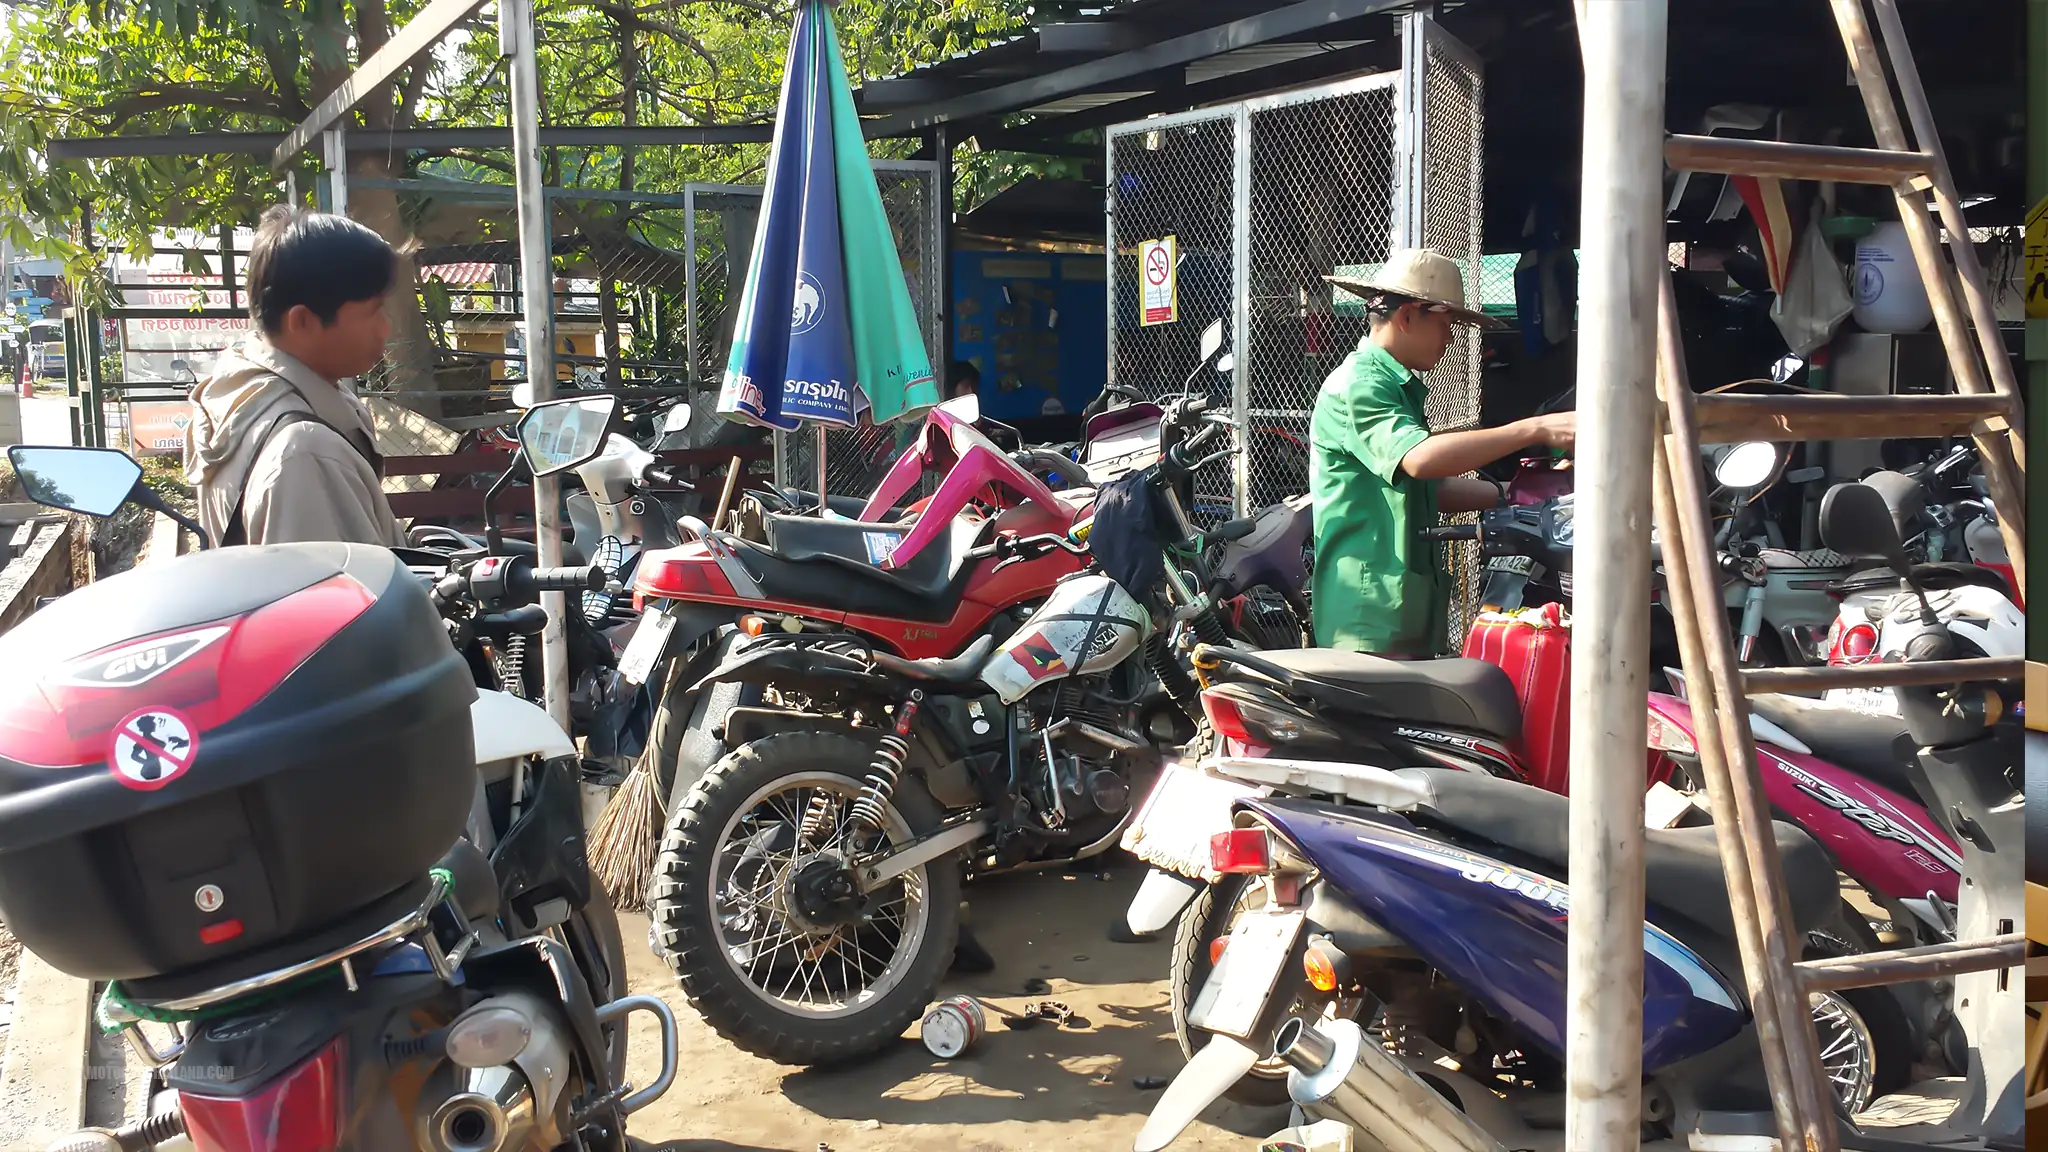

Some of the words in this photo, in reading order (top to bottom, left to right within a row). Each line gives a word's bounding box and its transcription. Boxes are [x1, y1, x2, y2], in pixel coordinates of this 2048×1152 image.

[797, 398, 833, 409] COMPANY
[102, 646, 168, 680] GIVI
[1777, 762, 1817, 788] SUZUKI
[1903, 849, 1949, 874] 125
